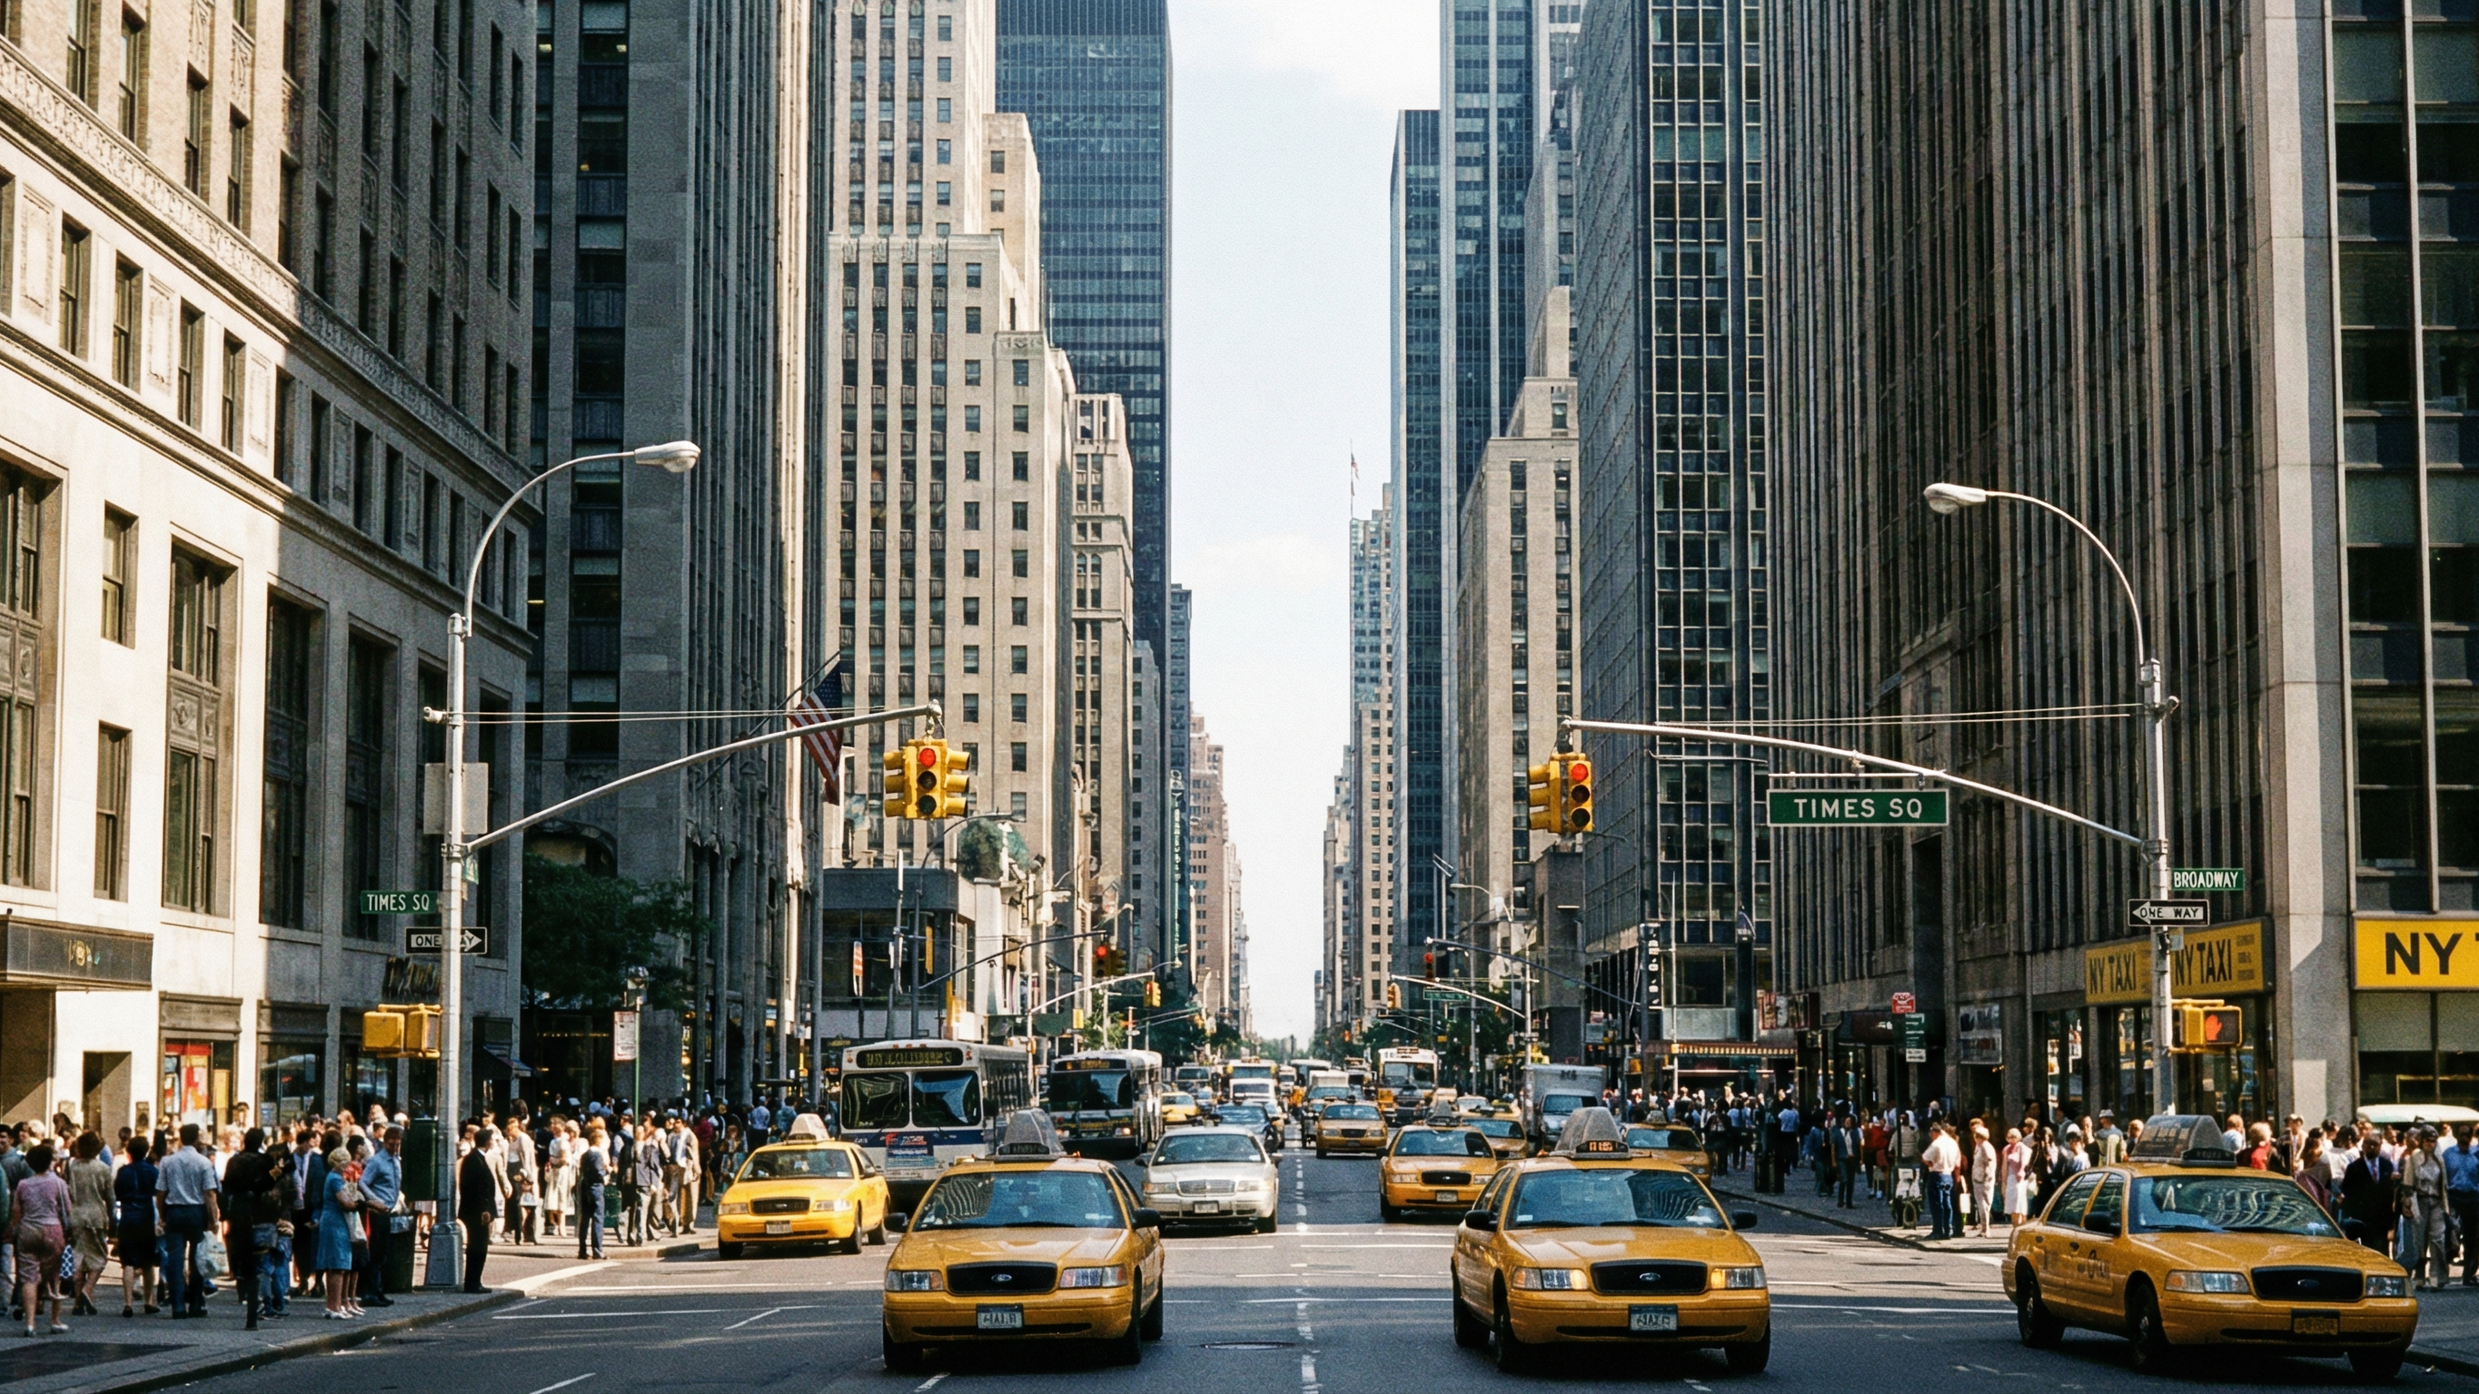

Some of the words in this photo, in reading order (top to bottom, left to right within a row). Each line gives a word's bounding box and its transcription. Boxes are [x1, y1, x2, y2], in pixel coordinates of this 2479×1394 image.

[1794, 798, 1875, 818] TIMES
[1889, 798, 1922, 819] SQ
[2173, 871, 2239, 888] BROADWAY
[367, 893, 407, 911] TIMES
[412, 894, 430, 911] SQ
[2173, 906, 2199, 918] WAY
[415, 935, 441, 947] ONE
[2174, 944, 2194, 987] NY
[2196, 938, 2232, 985] TAXI
[2385, 932, 2464, 975] NY
[2089, 956, 2106, 995] NY
[2108, 952, 2137, 994] TAXI
